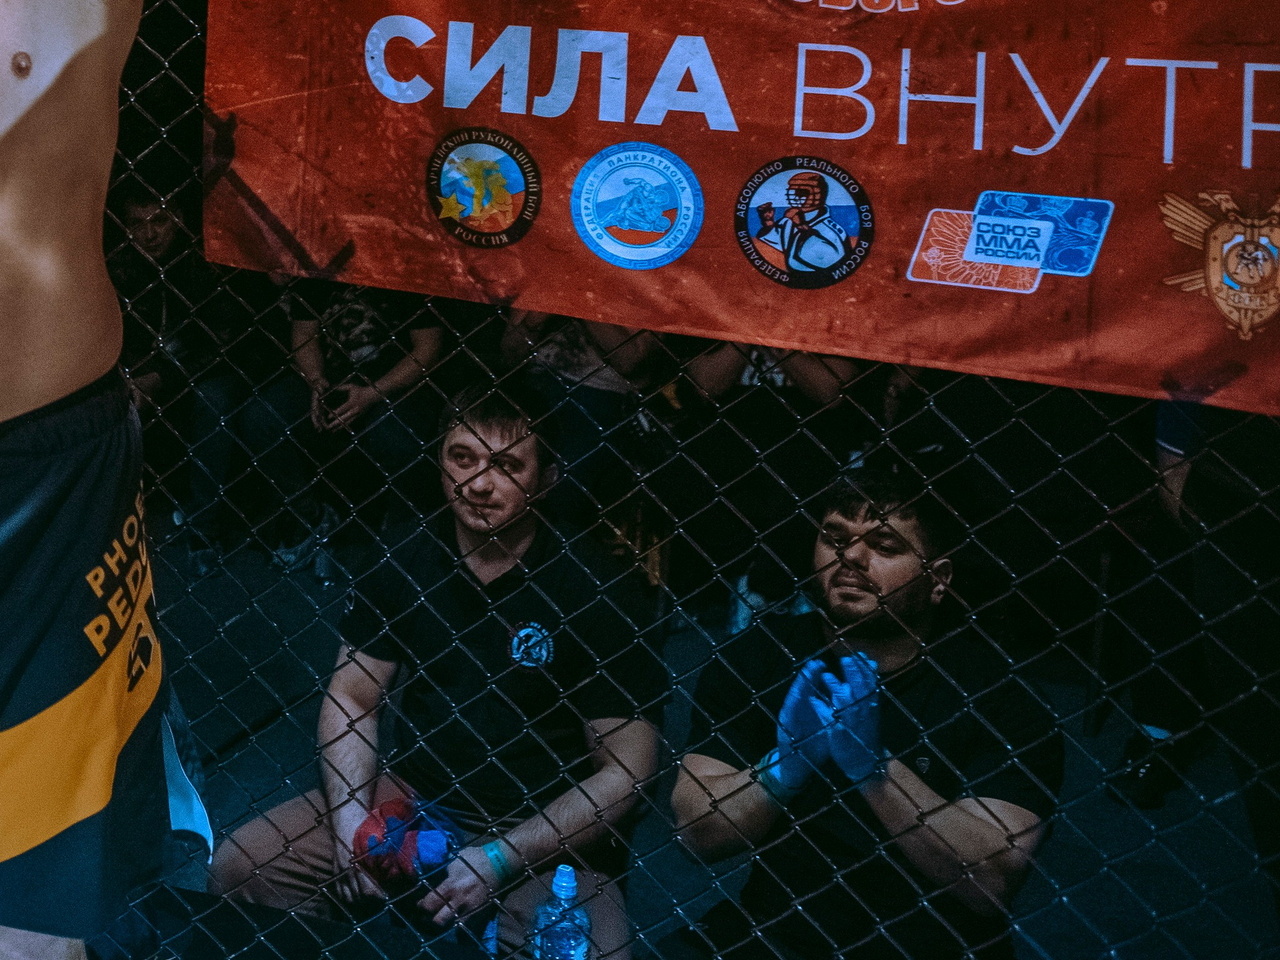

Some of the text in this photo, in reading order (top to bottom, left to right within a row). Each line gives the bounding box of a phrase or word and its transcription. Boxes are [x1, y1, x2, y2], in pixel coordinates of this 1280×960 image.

[364, 15, 739, 132] СИЛА
[583, 153, 691, 249] ФЕДЕРАЦИЯ ПАНКРАТИОНА РОССИИ
[736, 157, 872, 282] ФЕДЕРАЦИЯ АБСОЛЮТНО РЕАЛЬНОГО БОЯ РОССИИ
[454, 226, 509, 245] РОССИЯ
[976, 222, 1041, 238] СОЮЗ
[976, 234, 1041, 252] ММА
[974, 247, 1040, 261] РОССИИ
